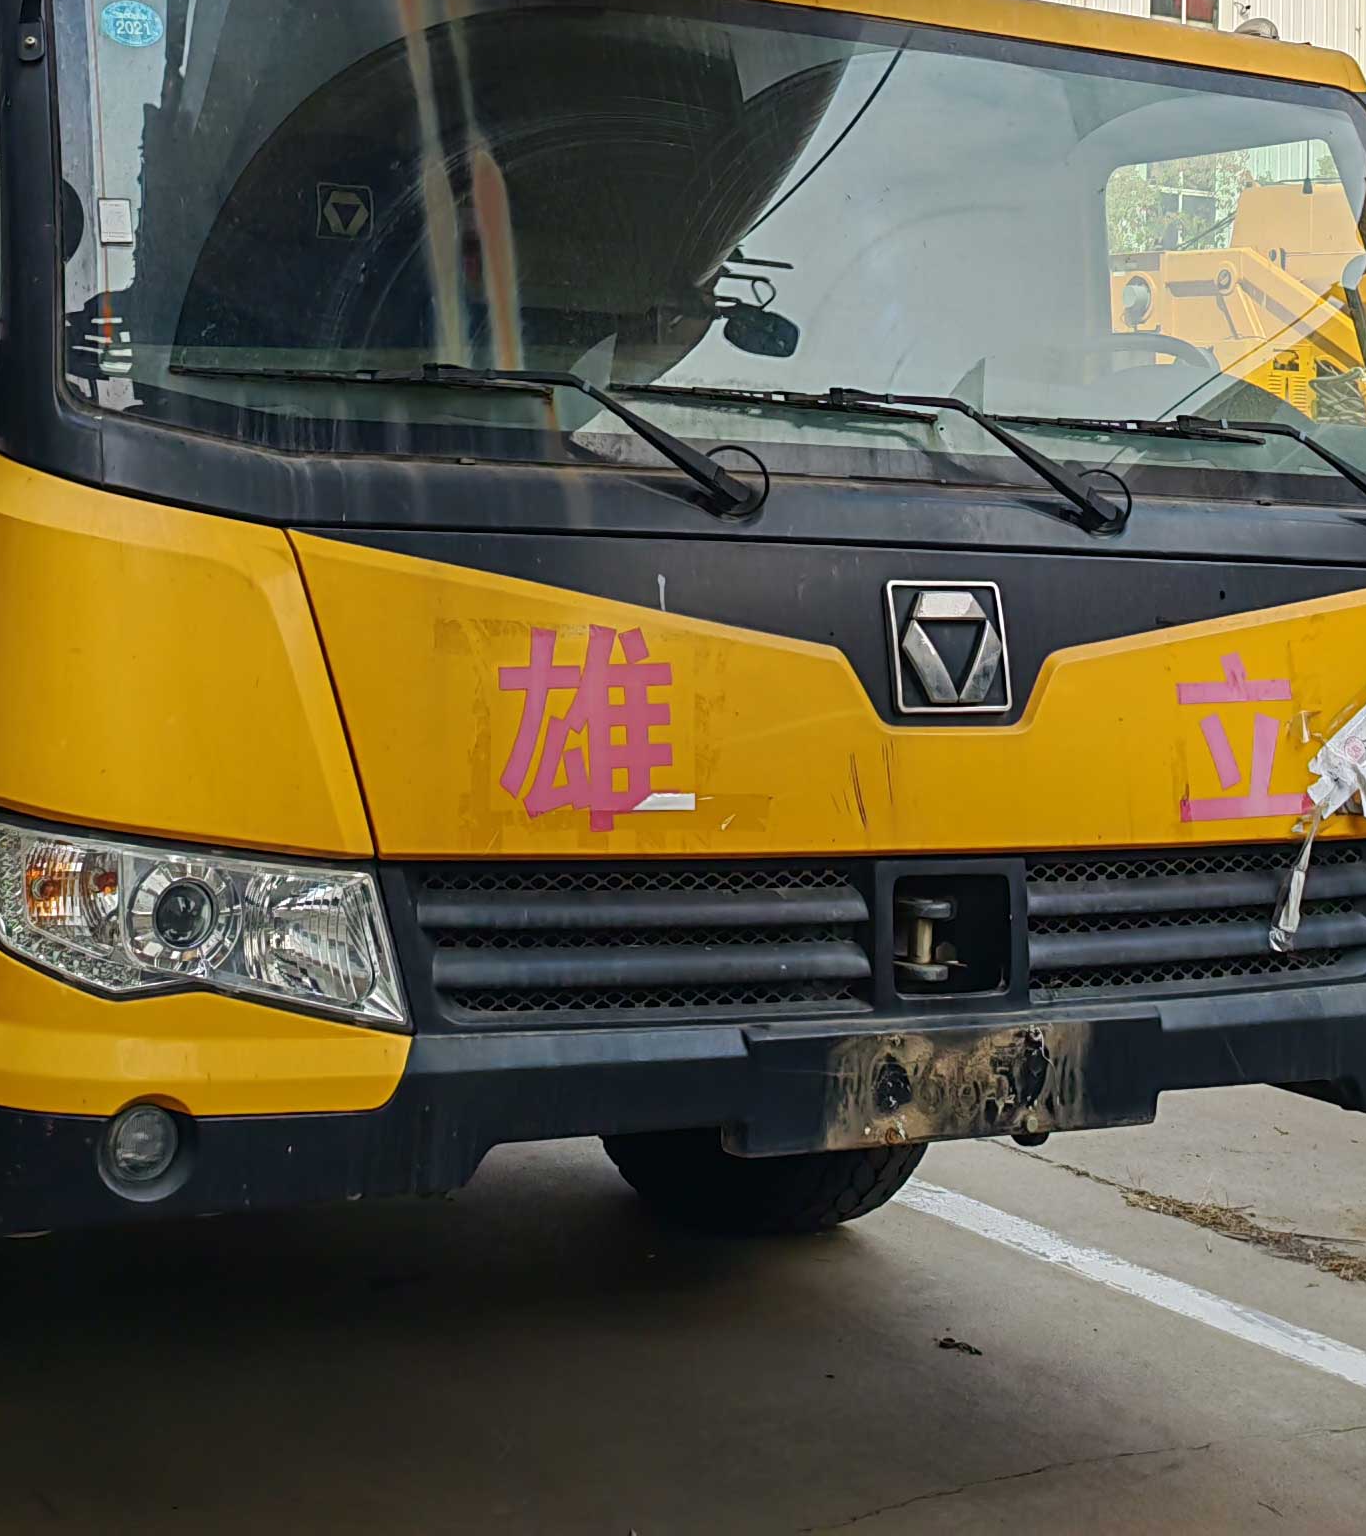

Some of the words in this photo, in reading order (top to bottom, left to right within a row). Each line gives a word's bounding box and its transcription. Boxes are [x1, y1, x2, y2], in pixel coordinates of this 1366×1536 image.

[115, 20, 152, 36] 2021
[497, 623, 674, 833] 雄
[1176, 651, 1313, 823] 立
